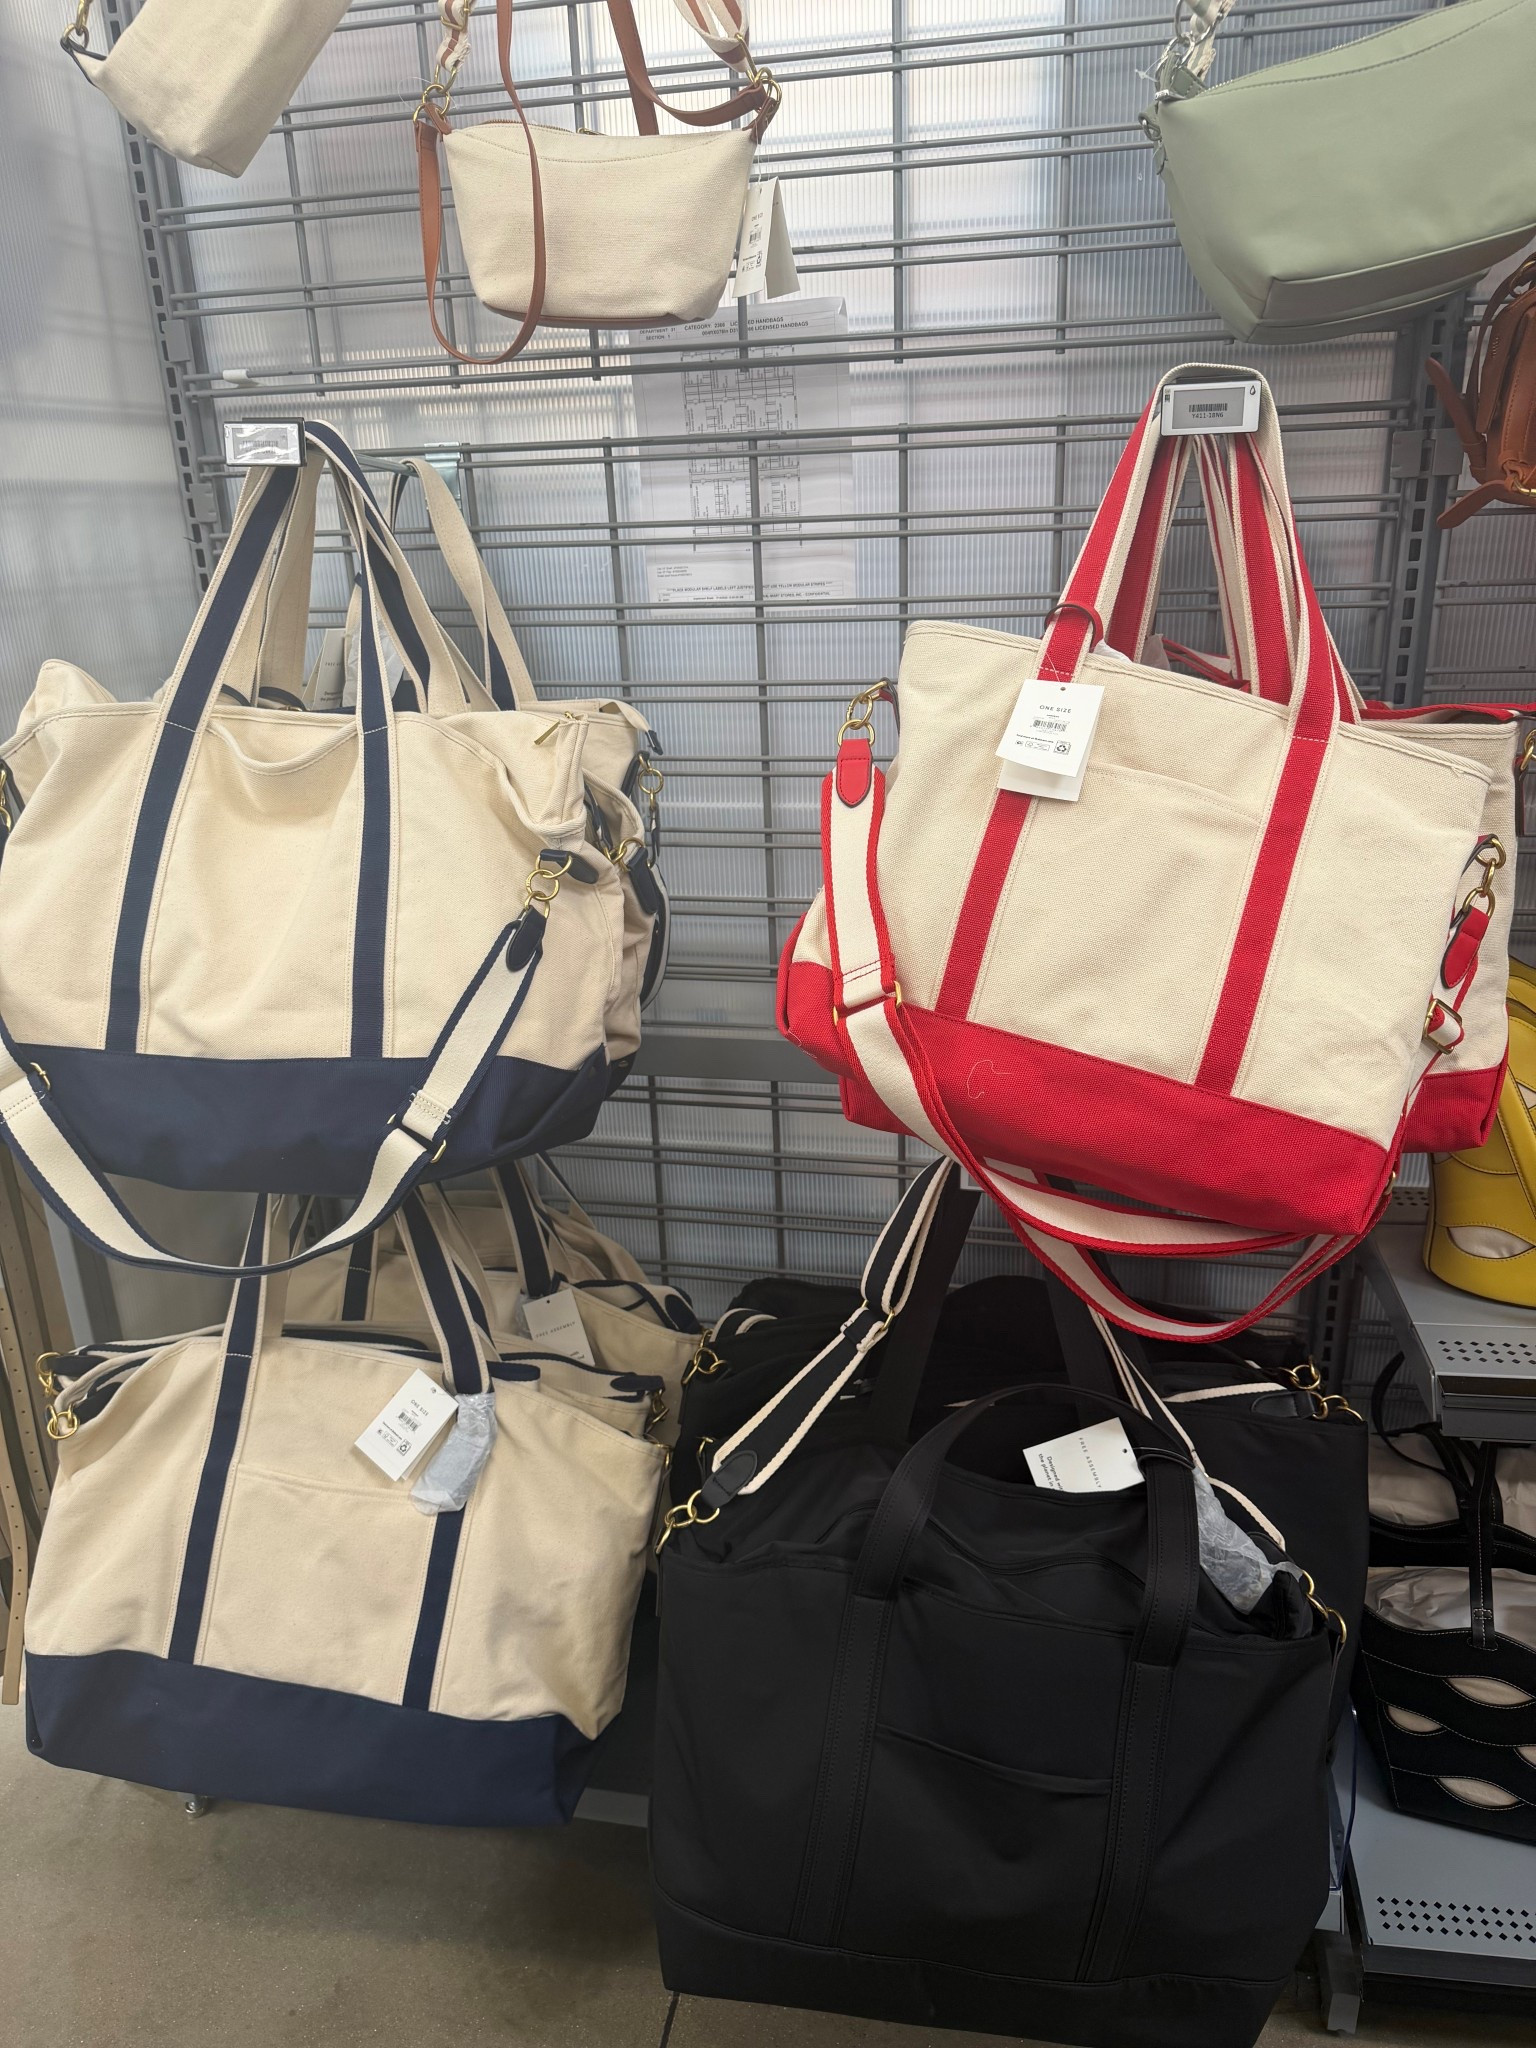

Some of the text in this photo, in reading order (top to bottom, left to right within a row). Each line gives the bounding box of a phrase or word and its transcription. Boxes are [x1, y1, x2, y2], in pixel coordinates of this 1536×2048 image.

[730, 319, 755, 327] LICED
[755, 316, 784, 324] HANDBAGS
[754, 324, 780, 332] LICENSED
[780, 321, 809, 329] HANDBAGS
[1046, 1455, 1060, 1482] Designed
[1079, 1437, 1102, 1488] FREE ASSEMBLY
[1041, 1463, 1052, 1481] planet
